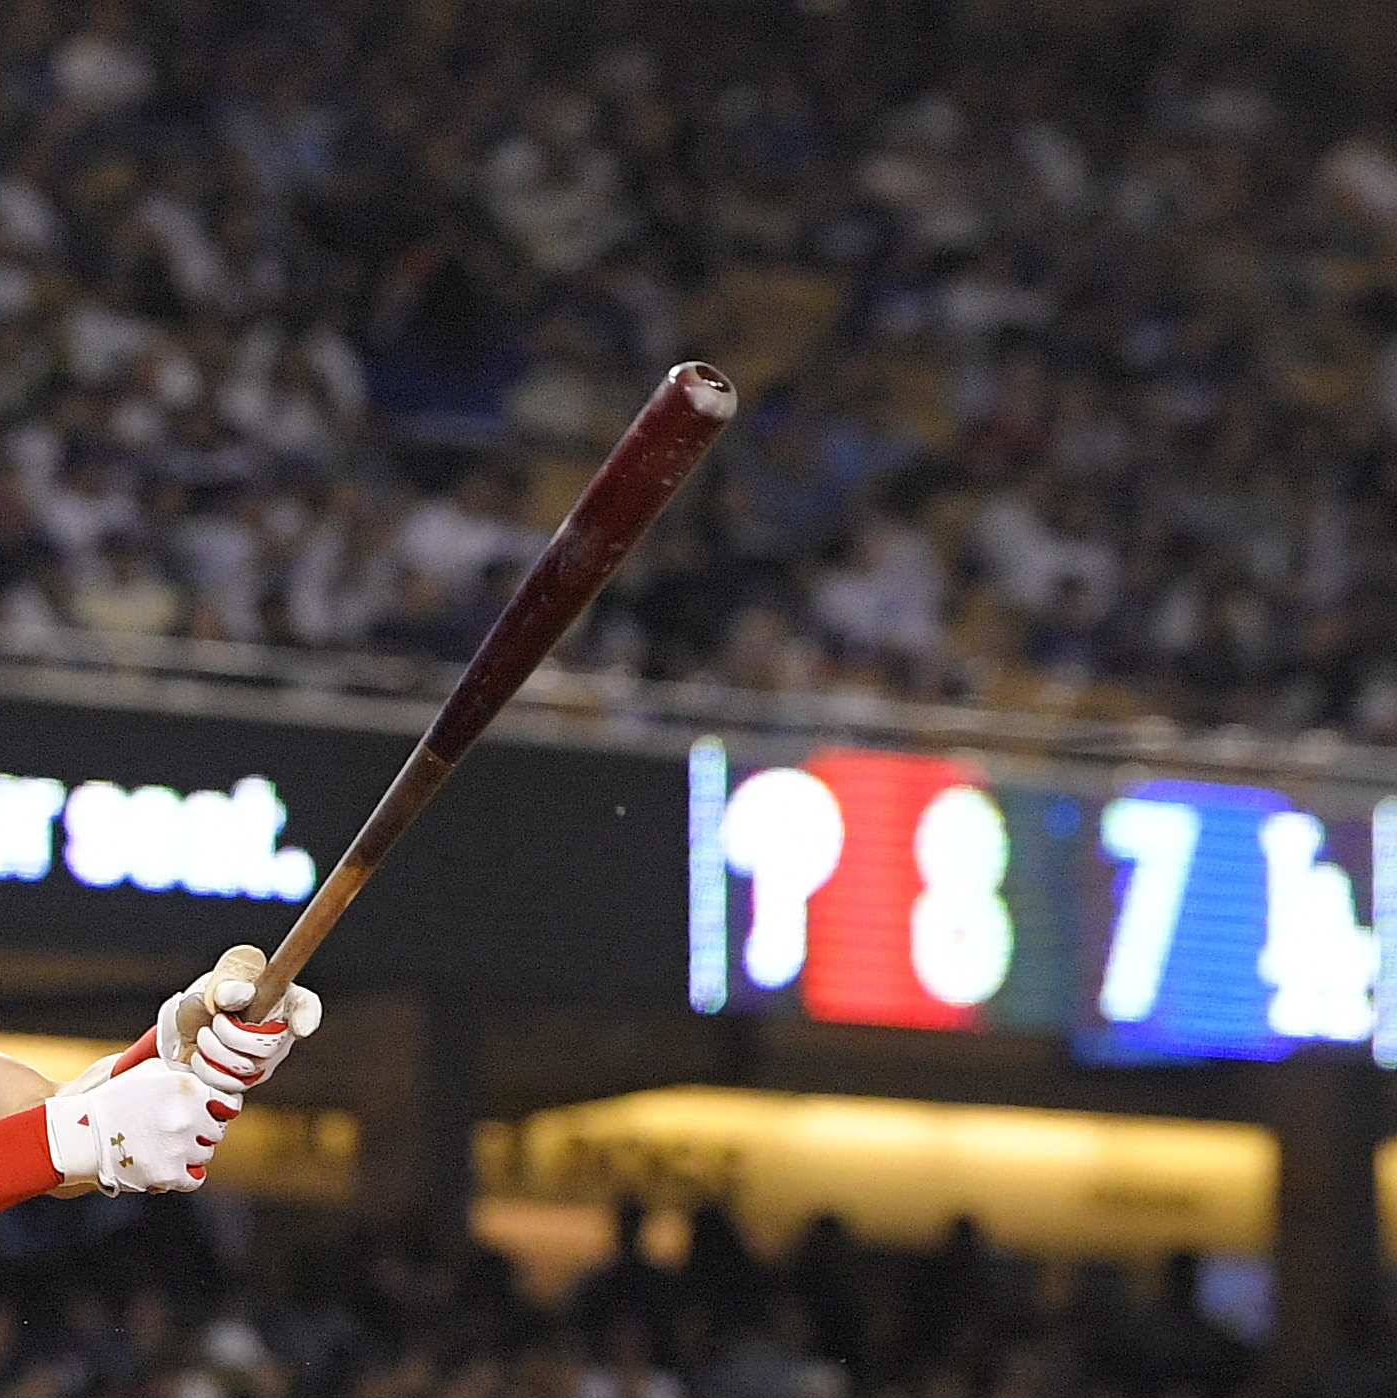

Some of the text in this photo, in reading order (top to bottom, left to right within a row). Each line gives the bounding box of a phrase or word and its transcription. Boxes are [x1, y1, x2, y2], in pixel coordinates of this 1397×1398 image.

[65, 774, 317, 903] seat.
[910, 784, 1012, 1007] 8
[1100, 797, 1200, 1022] 7
